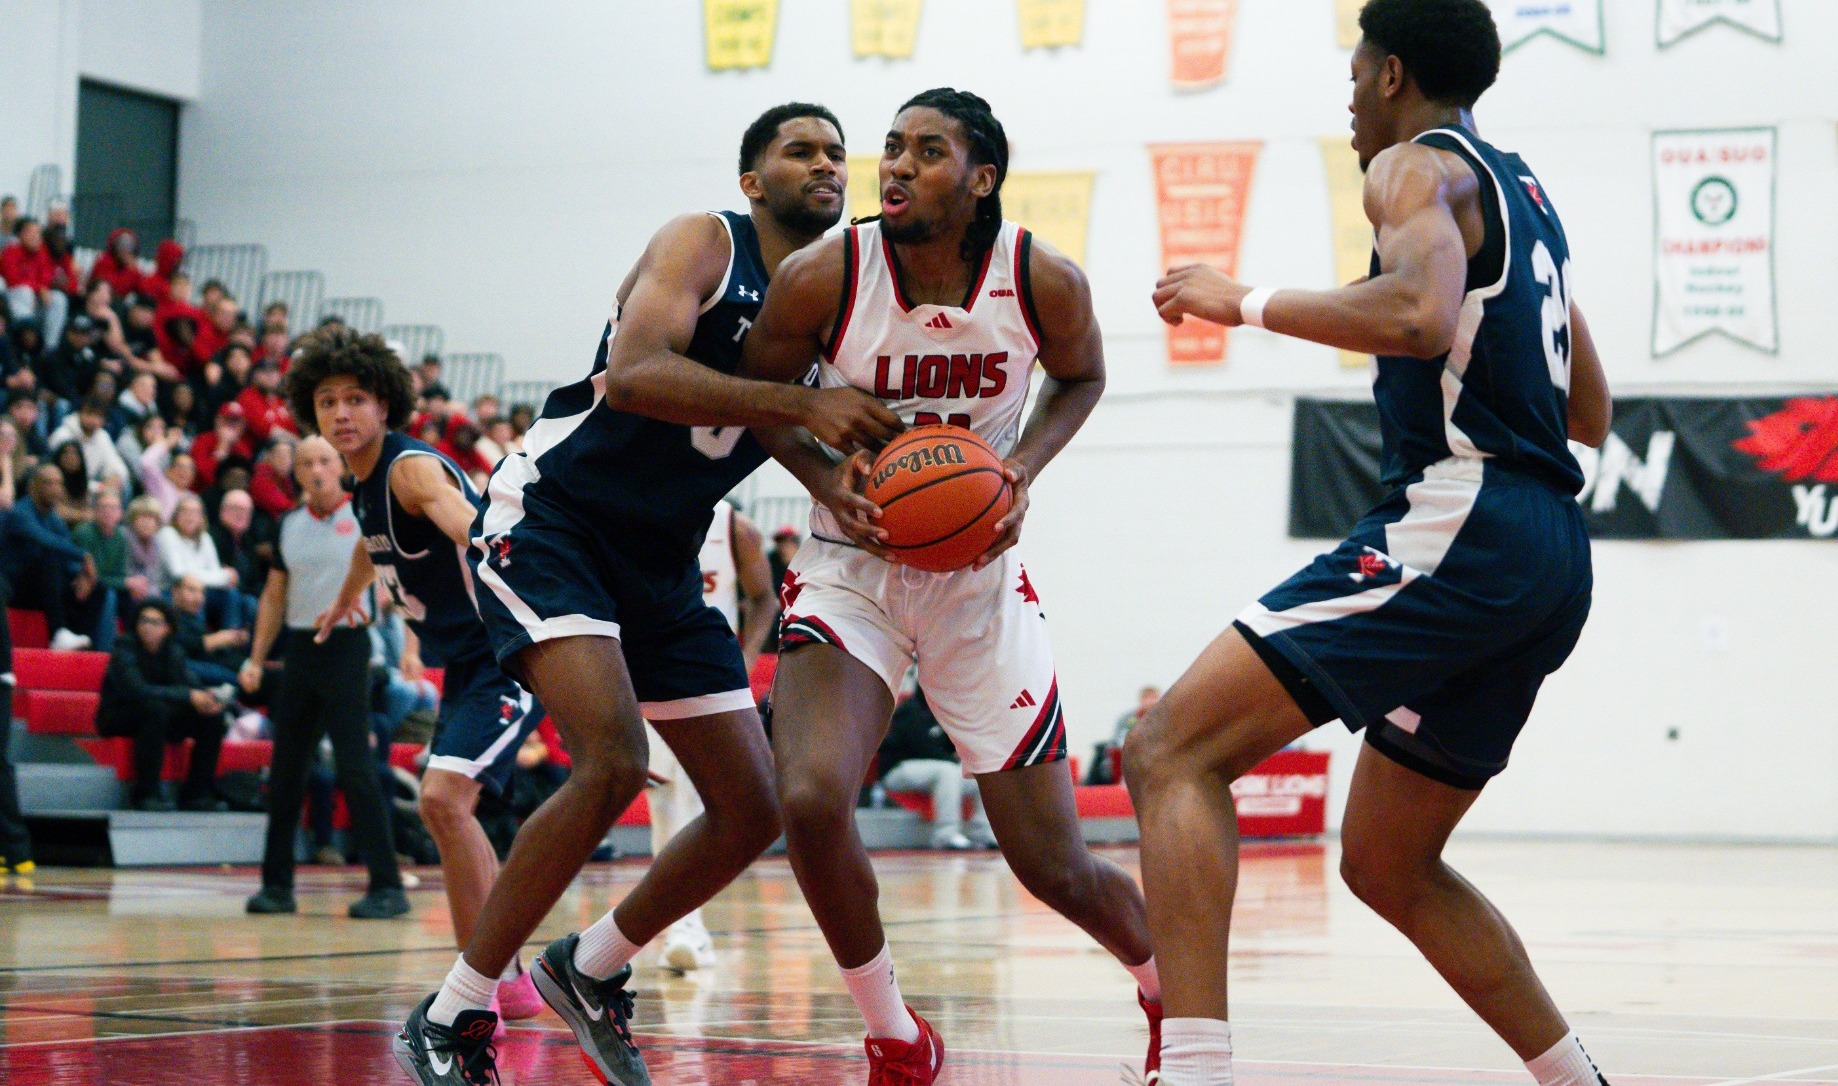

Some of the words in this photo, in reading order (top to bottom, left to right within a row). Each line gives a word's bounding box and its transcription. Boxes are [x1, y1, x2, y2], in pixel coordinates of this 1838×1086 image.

[988, 288, 1015, 298] OUA
[874, 351, 1009, 401] LIONS
[872, 443, 967, 490] Wilson
